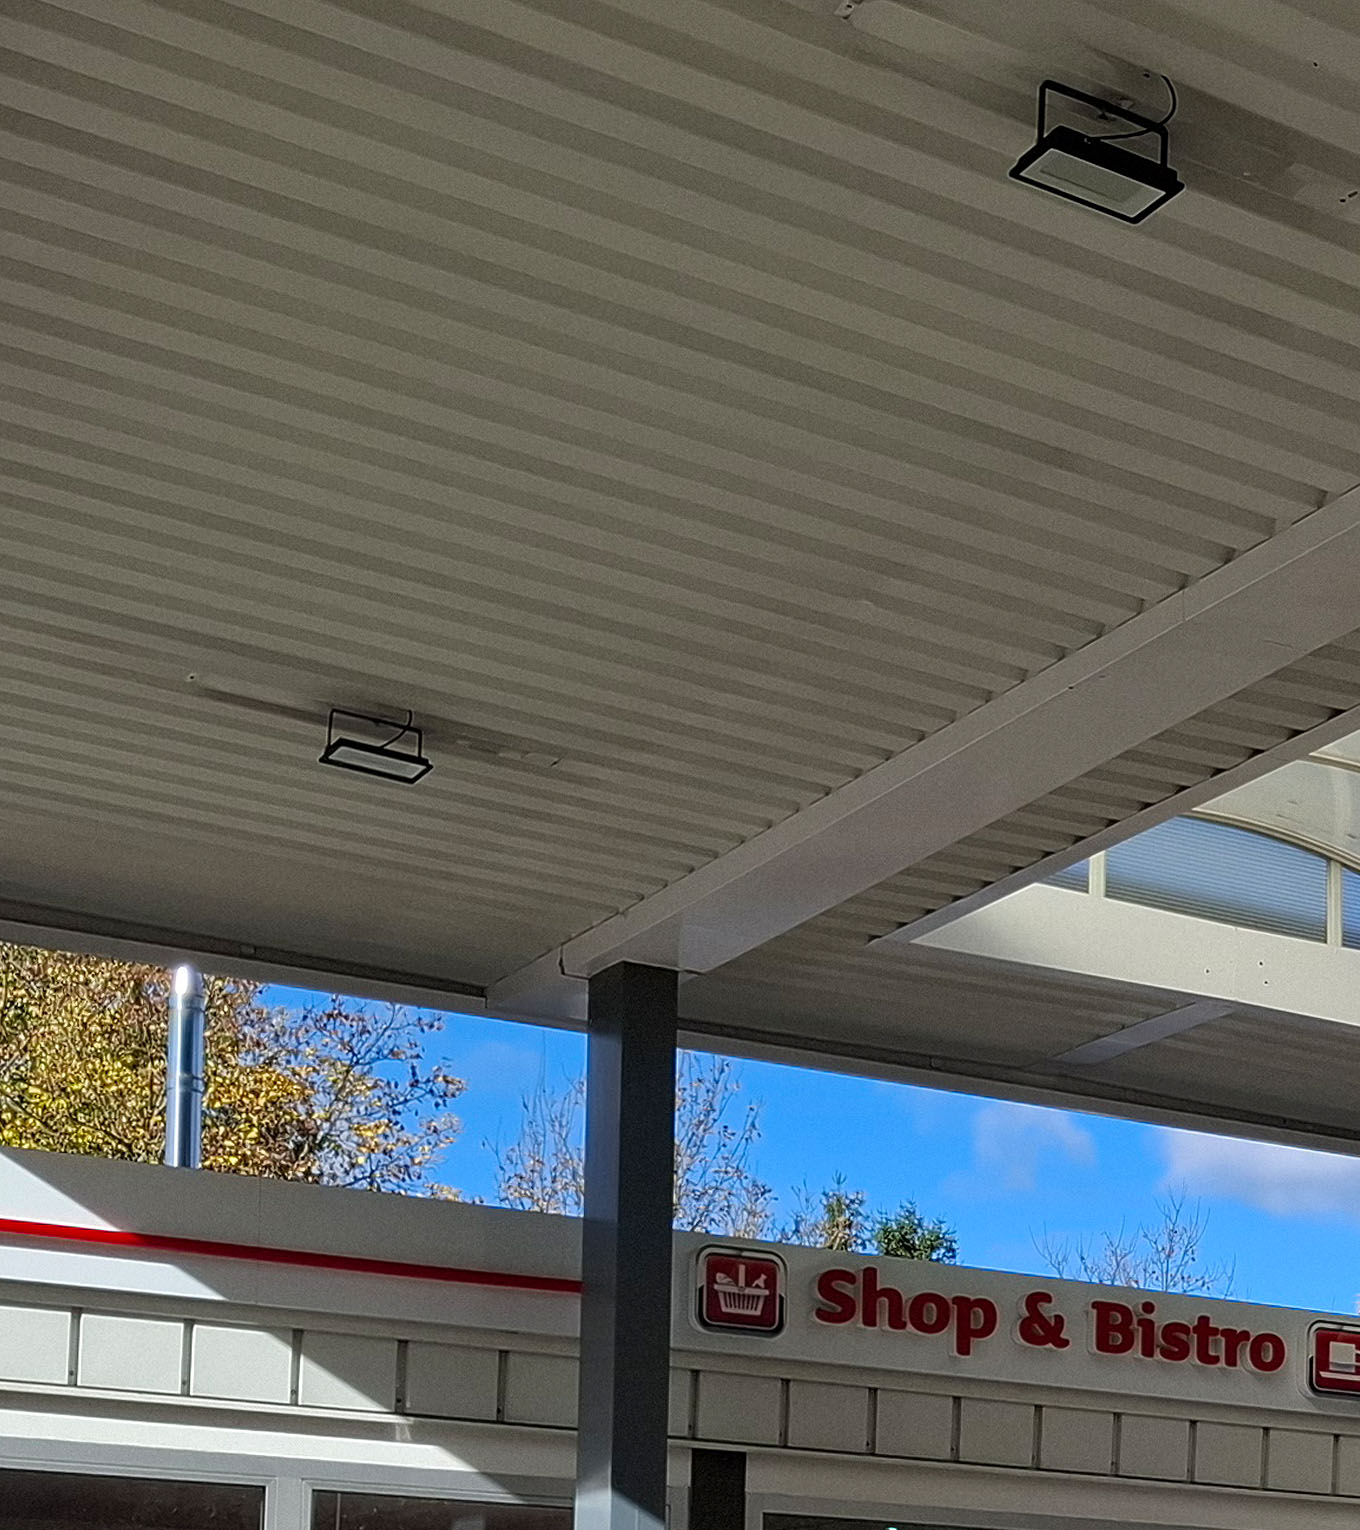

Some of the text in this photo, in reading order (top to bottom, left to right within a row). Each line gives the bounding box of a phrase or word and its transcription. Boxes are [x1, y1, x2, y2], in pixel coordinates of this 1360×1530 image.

[814, 1266, 1287, 1372] Shop & Bistro
